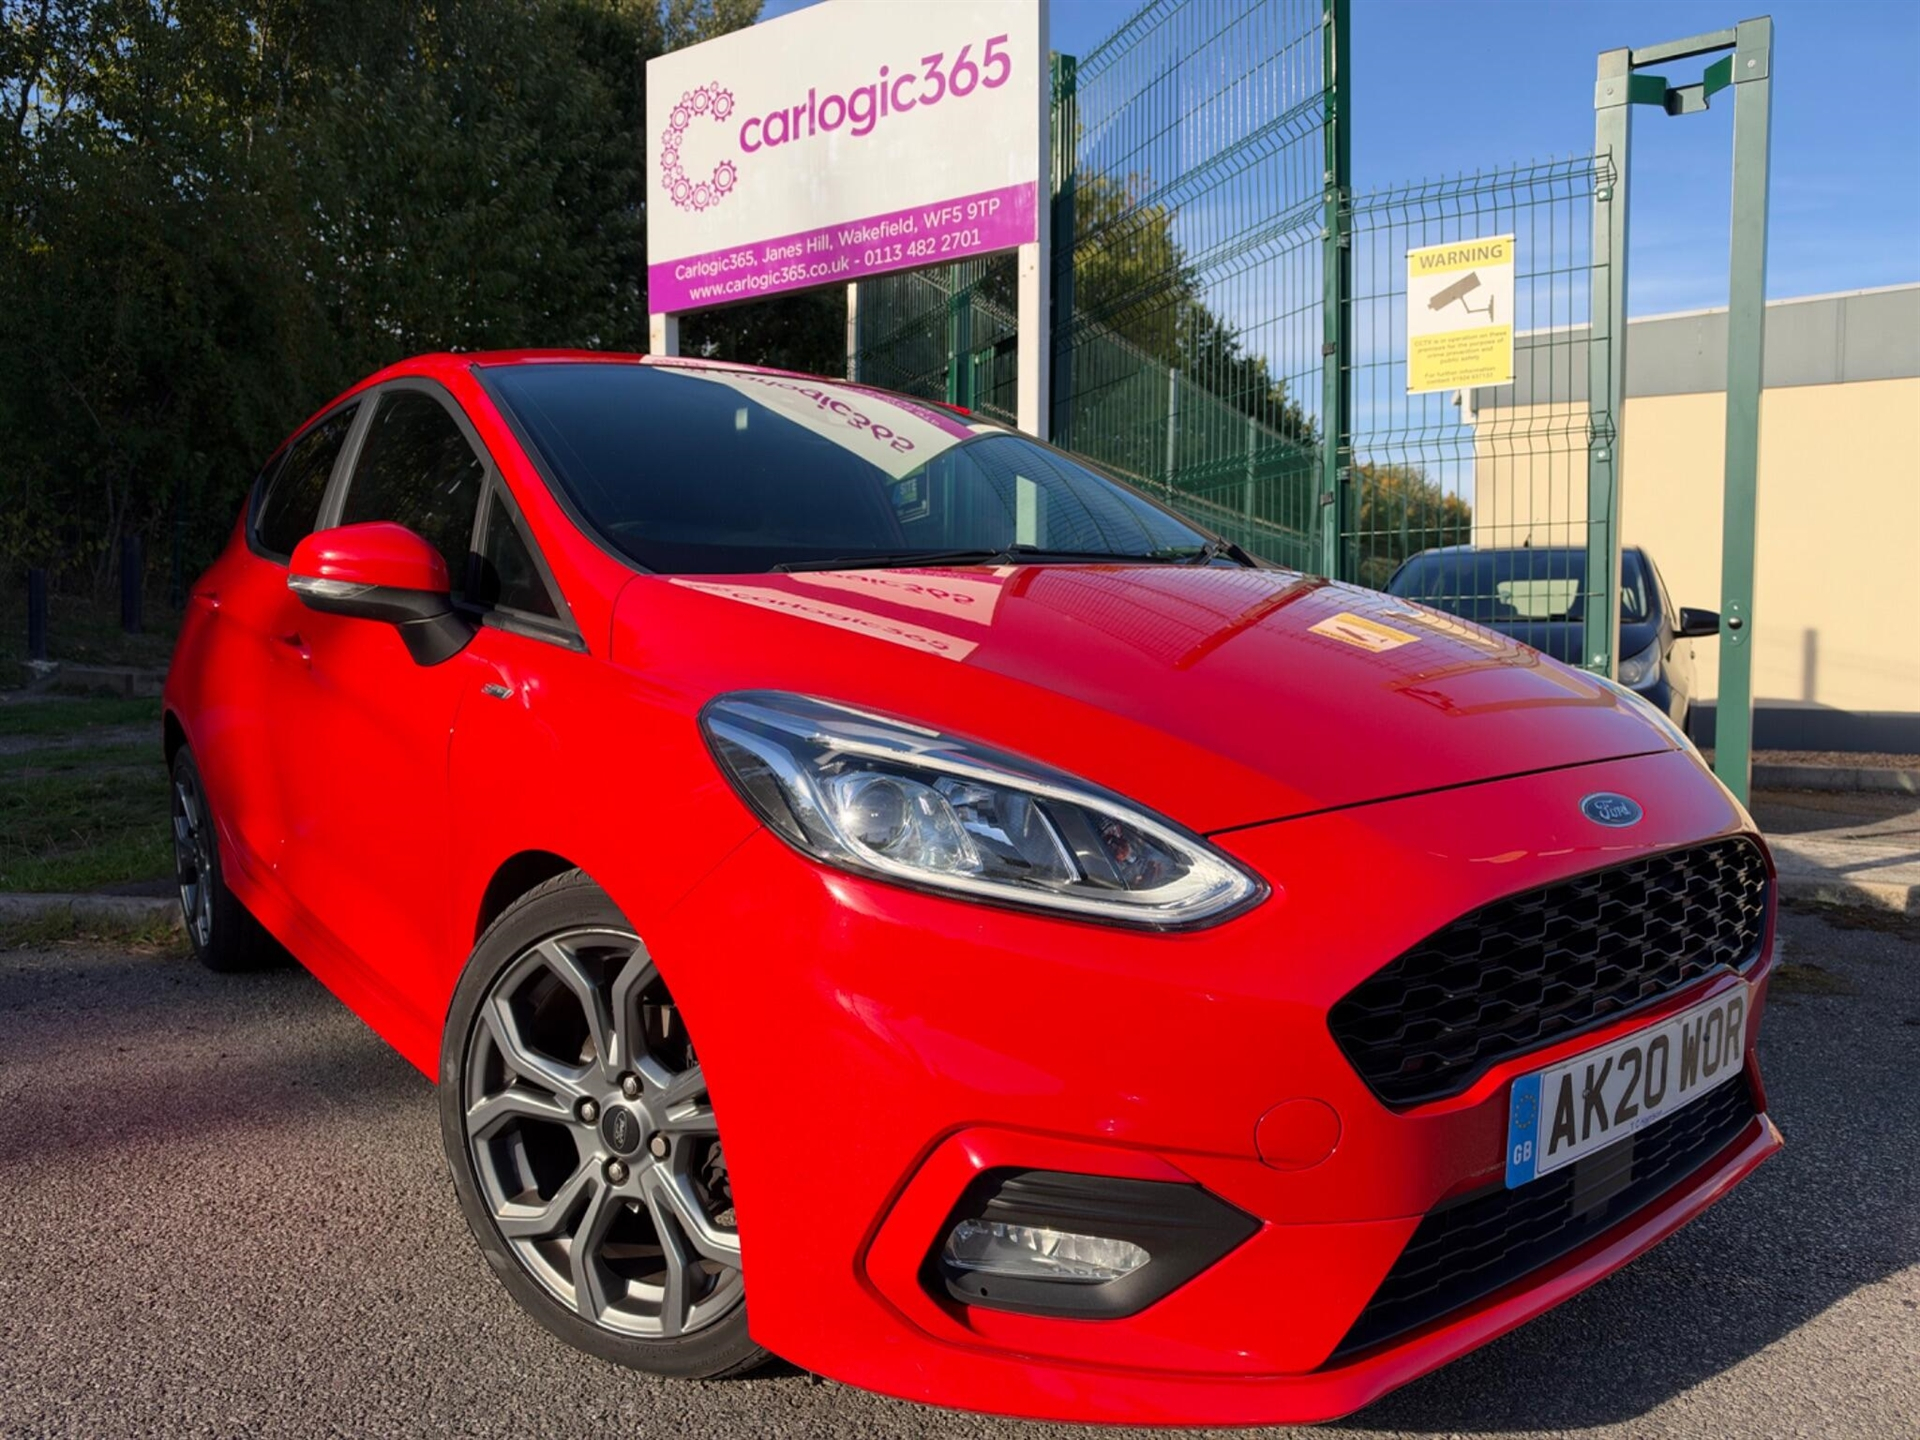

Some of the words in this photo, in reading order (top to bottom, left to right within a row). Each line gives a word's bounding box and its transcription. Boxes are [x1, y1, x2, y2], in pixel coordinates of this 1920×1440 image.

[739, 33, 1011, 153] carlogic365
[675, 251, 757, 280] Carlogic365,
[762, 244, 802, 263] Janes
[806, 233, 833, 253] Hill,
[838, 216, 917, 247] Wakefield,
[923, 205, 962, 229] WF5
[967, 197, 1000, 219] 9TP
[690, 255, 849, 300] www.carlogic365.co.uk
[864, 244, 902, 266] 0113
[907, 237, 936, 258] 482
[941, 228, 981, 251] 2701
[1419, 244, 1503, 269] WARNING
[1594, 799, 1631, 820] Ford
[1547, 1035, 1669, 1156] AK20
[1679, 995, 1744, 1093] WOR
[1513, 1140, 1532, 1165] GB
